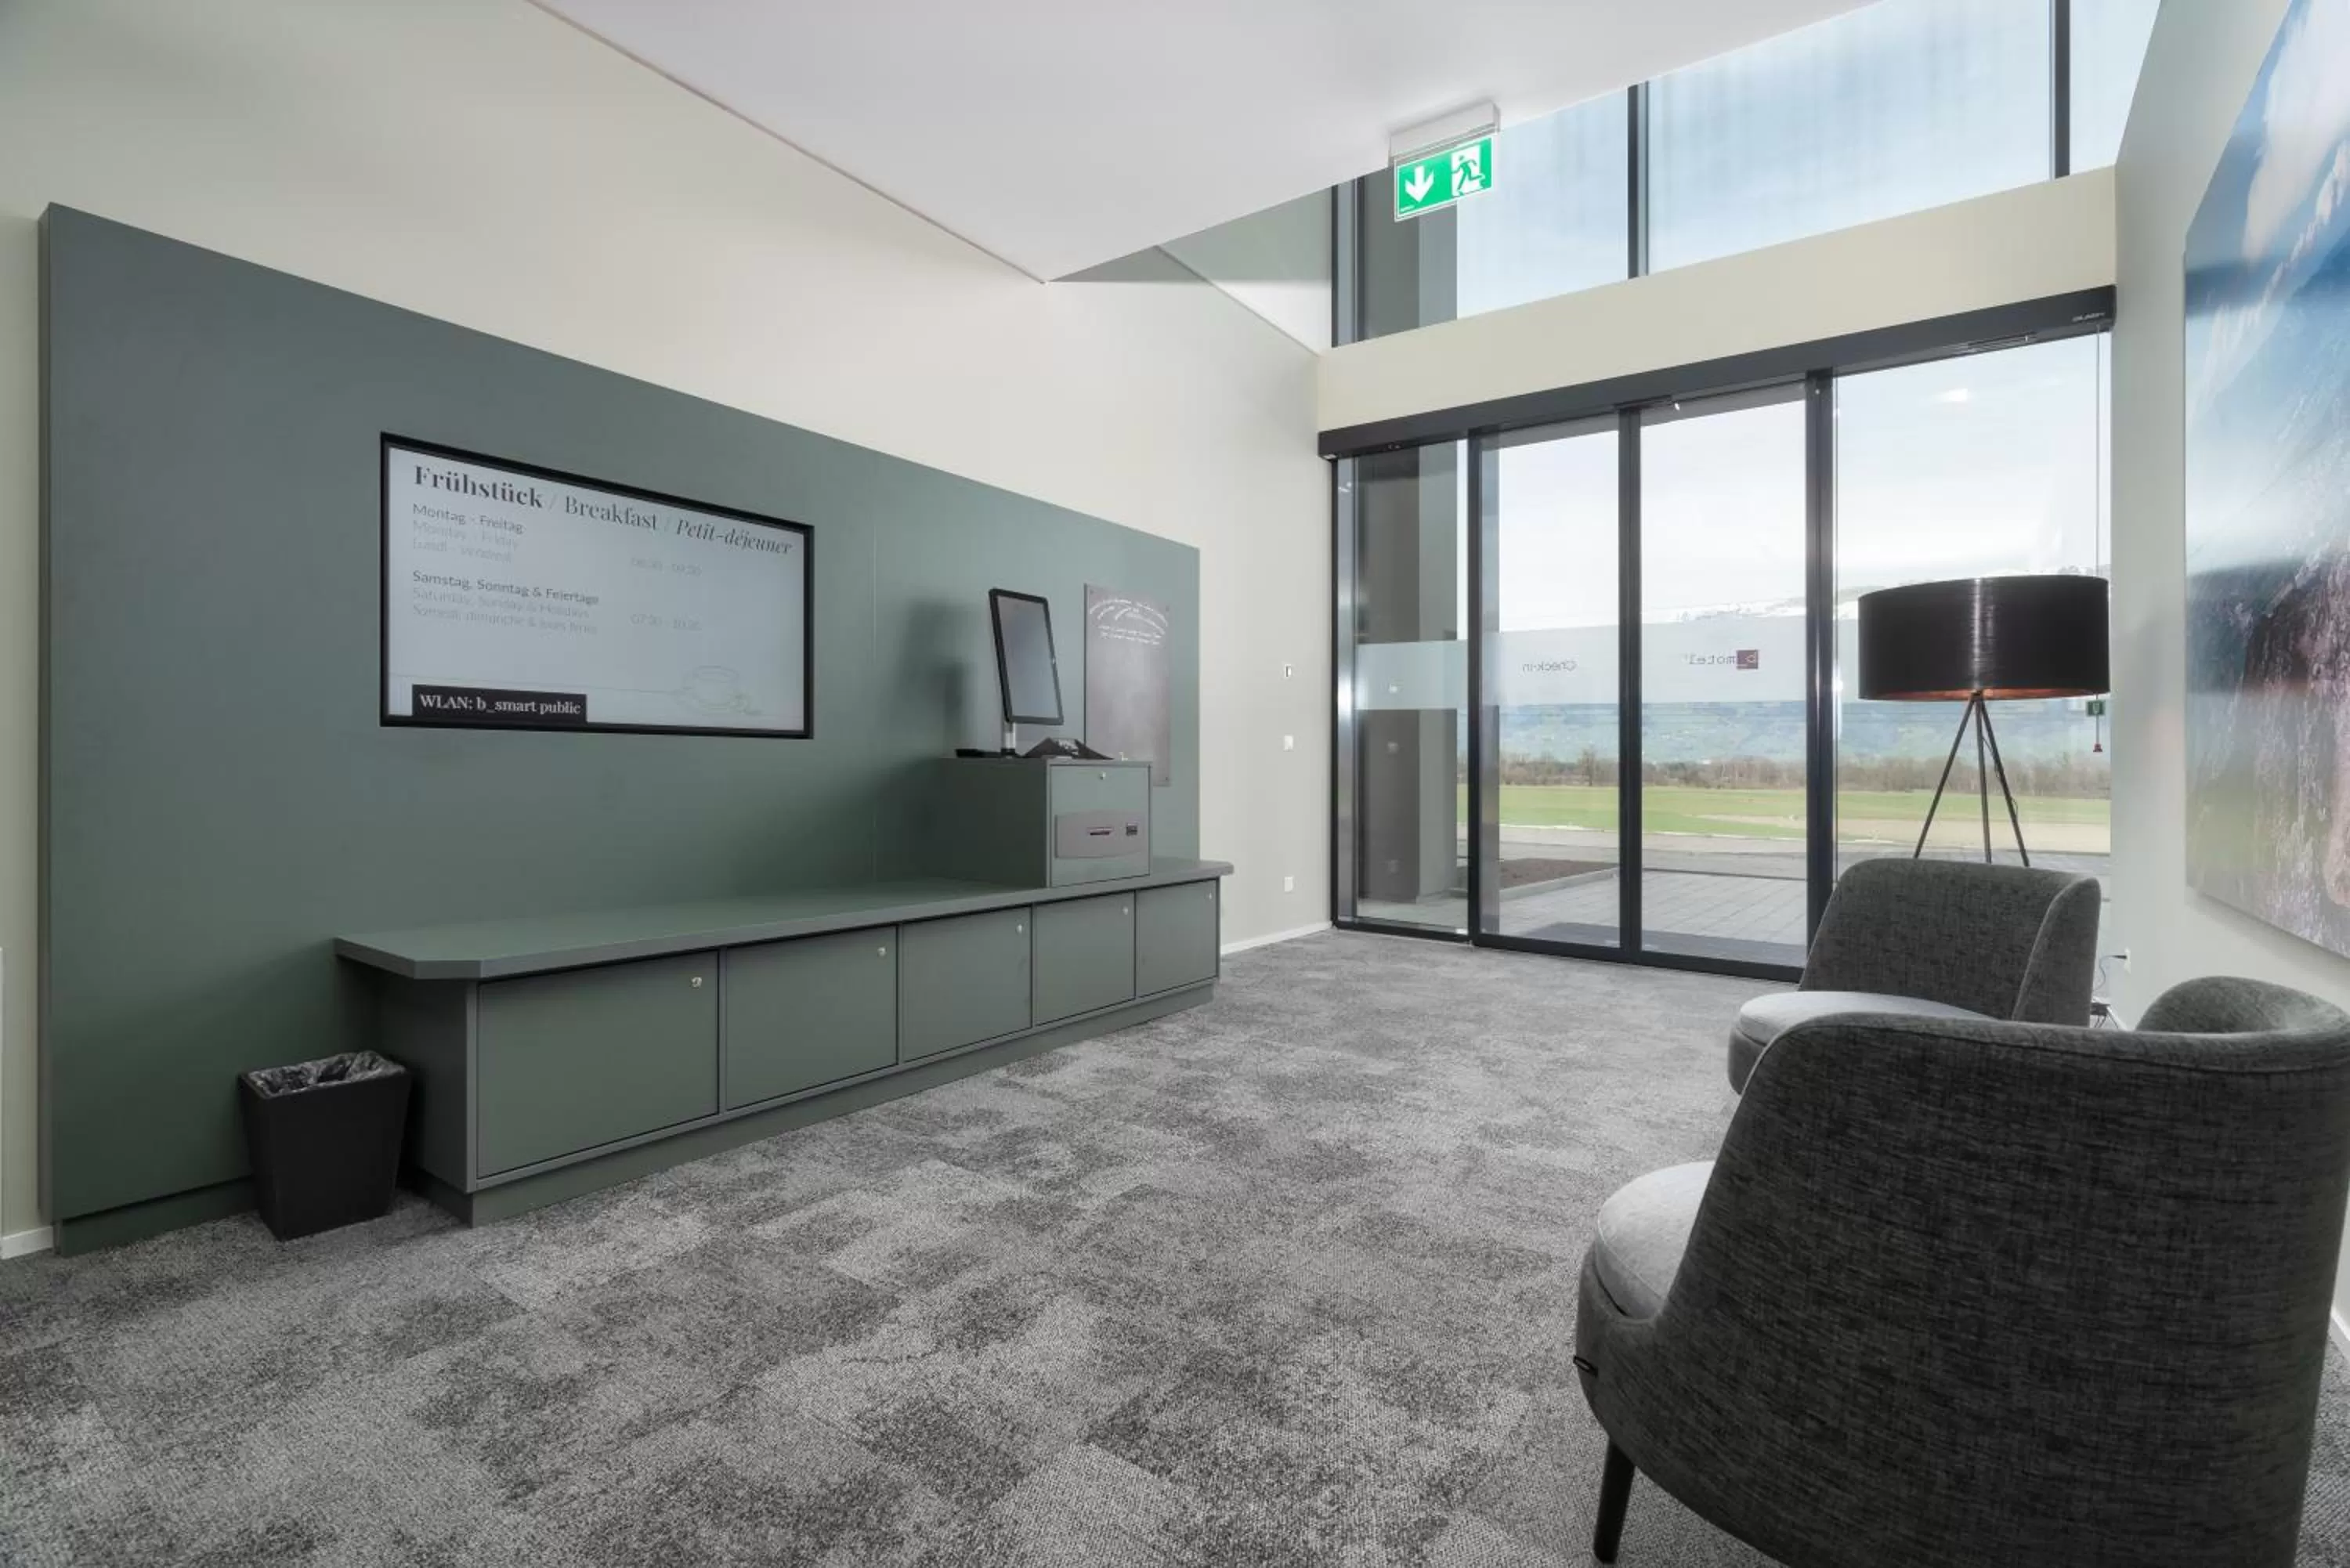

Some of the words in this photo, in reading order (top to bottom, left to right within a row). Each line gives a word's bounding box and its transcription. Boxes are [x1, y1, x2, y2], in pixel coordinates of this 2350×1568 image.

[413, 503, 467, 526] Montag
[479, 514, 525, 535] Freitag
[415, 465, 543, 509] Frühstück
[565, 495, 656, 531] Breakfast
[675, 518, 793, 555] Petit-déjeuner
[477, 578, 530, 598] Sonntag
[533, 587, 542, 598] &
[546, 587, 599, 605] Feiertage
[419, 693, 473, 710] WLAN:
[476, 695, 536, 714] b_smart
[539, 700, 582, 716] public
